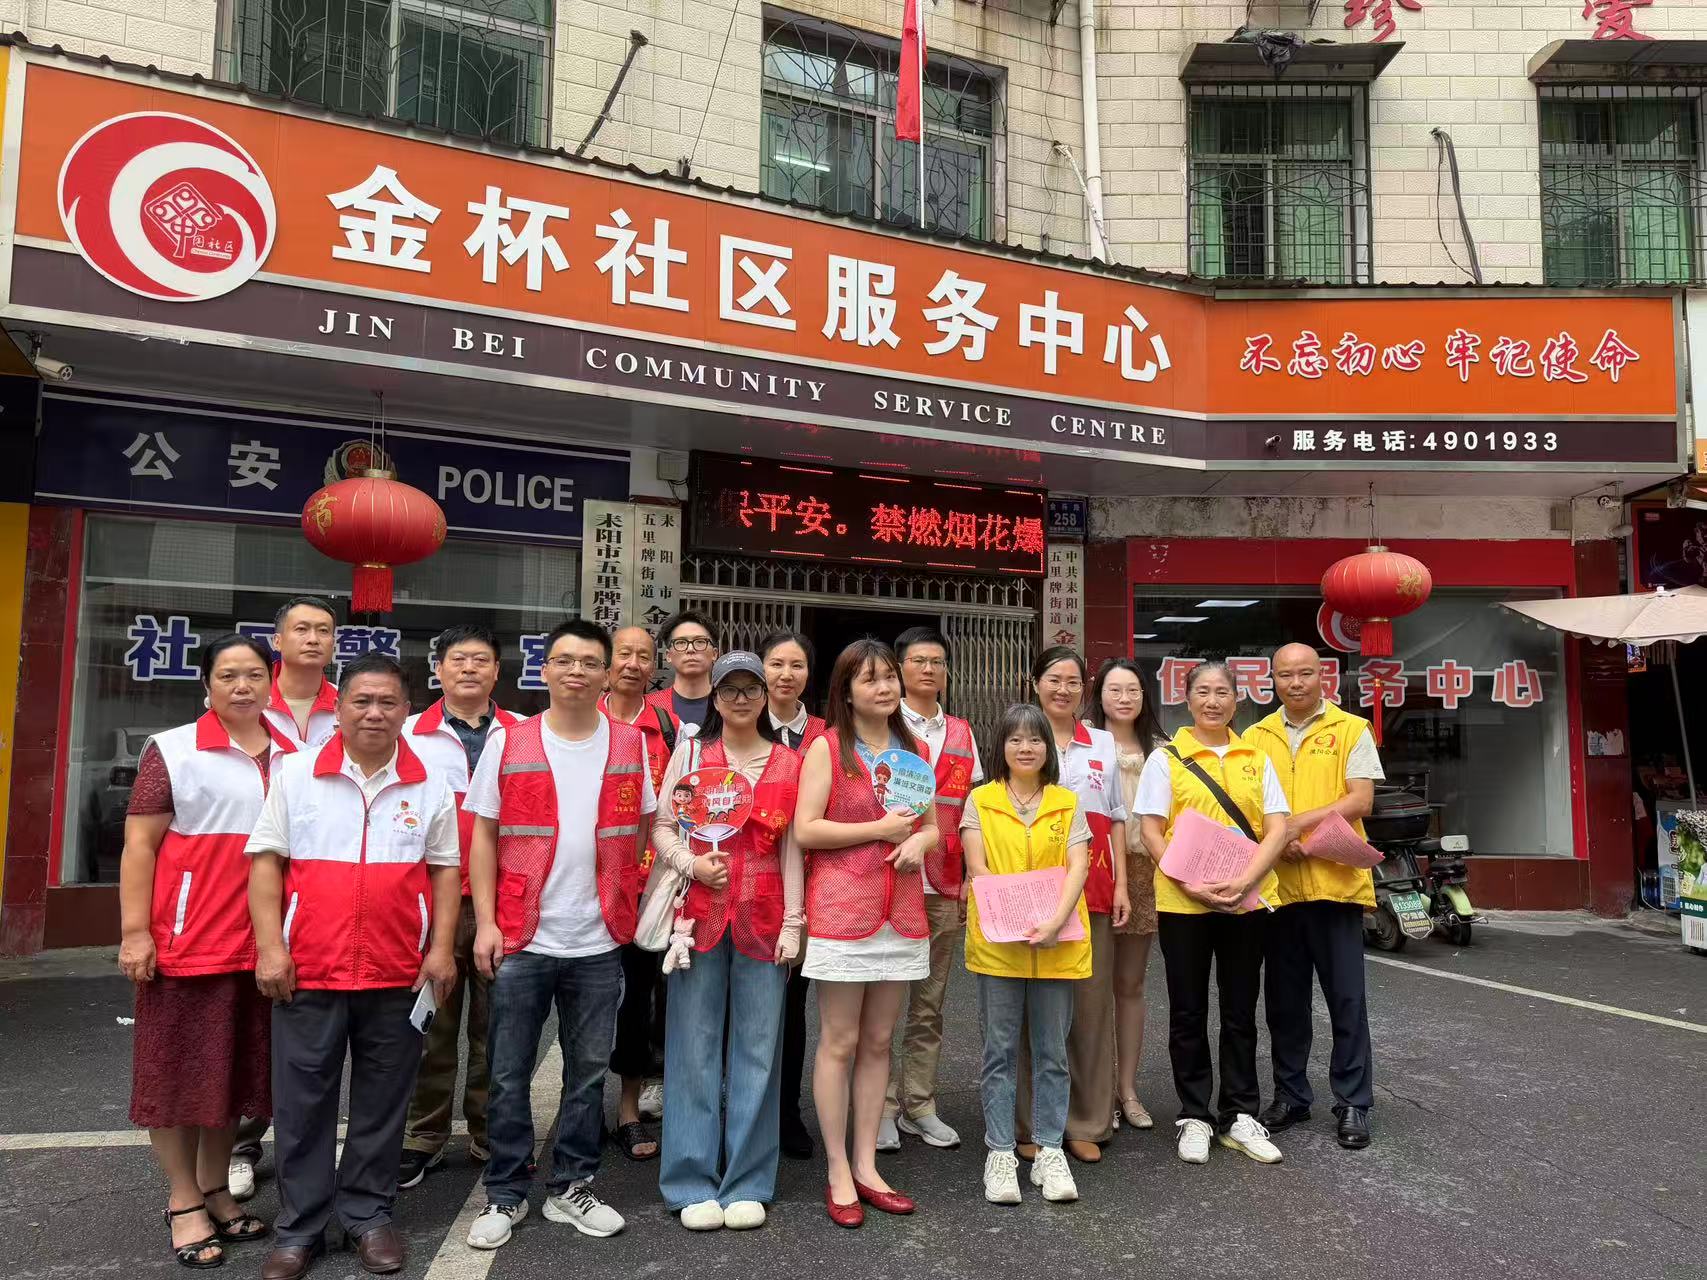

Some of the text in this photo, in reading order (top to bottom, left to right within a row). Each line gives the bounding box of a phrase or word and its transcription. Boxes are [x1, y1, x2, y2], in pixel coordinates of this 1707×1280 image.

[326, 164, 1172, 383] 金杯社区服务中心
[318, 309, 1167, 446] JIN BEI COMMUNITY SERVICE CENTRE
[1240, 329, 1640, 384] 不忘初心 牢记使命
[122, 431, 282, 491] 公安
[1292, 429, 1558, 452] 服务电话:4901933
[438, 465, 575, 512] POLICE
[1054, 512, 1077, 526] 258
[641, 513, 656, 598] 五里牌街道
[1049, 551, 1062, 625] 五里牌街道
